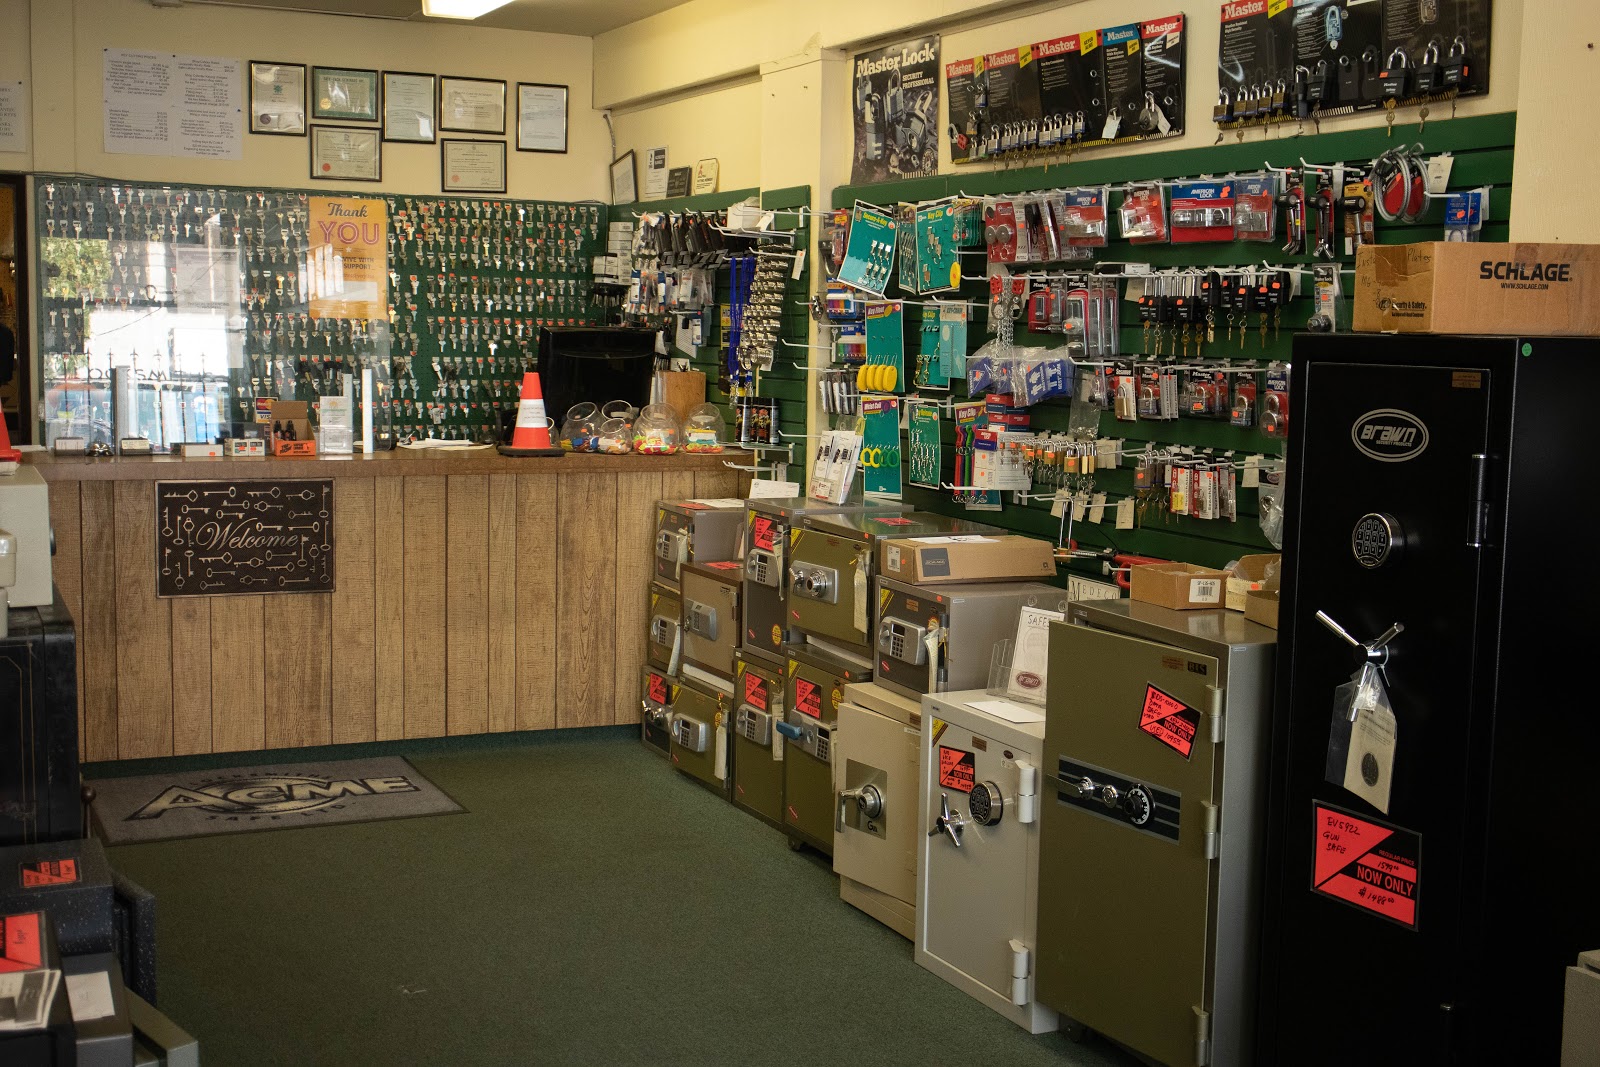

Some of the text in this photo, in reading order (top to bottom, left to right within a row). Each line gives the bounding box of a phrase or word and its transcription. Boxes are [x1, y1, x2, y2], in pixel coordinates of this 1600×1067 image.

[1224, 1, 1264, 20] Master
[1145, 22, 1177, 34] Master
[1106, 30, 1134, 41] Master
[1039, 40, 1075, 55] Master
[856, 43, 936, 78] Master Lock
[988, 53, 1016, 67] Master
[902, 71, 923, 82] SECURITY
[948, 63, 973, 76] Master
[902, 77, 935, 89] PROFESSIONAL
[328, 203, 368, 217] Thank
[927, 209, 944, 220] Key Clip
[317, 221, 379, 245] YOU
[1480, 261, 1571, 282] SCHLAGE
[1501, 282, 1549, 290] WWW.SCHLAGE.COM
[958, 409, 977, 418] Key Clip
[1361, 425, 1417, 443] Brawn
[196, 517, 298, 550] Welcome
[1164, 720, 1192, 741] NOW ONLY
[121, 776, 421, 821] ACME
[1327, 817, 1361, 836] EV5922
[1323, 831, 1340, 841] GUN
[1326, 843, 1347, 854] SAFE
[1357, 865, 1414, 897] NOW ONLY
